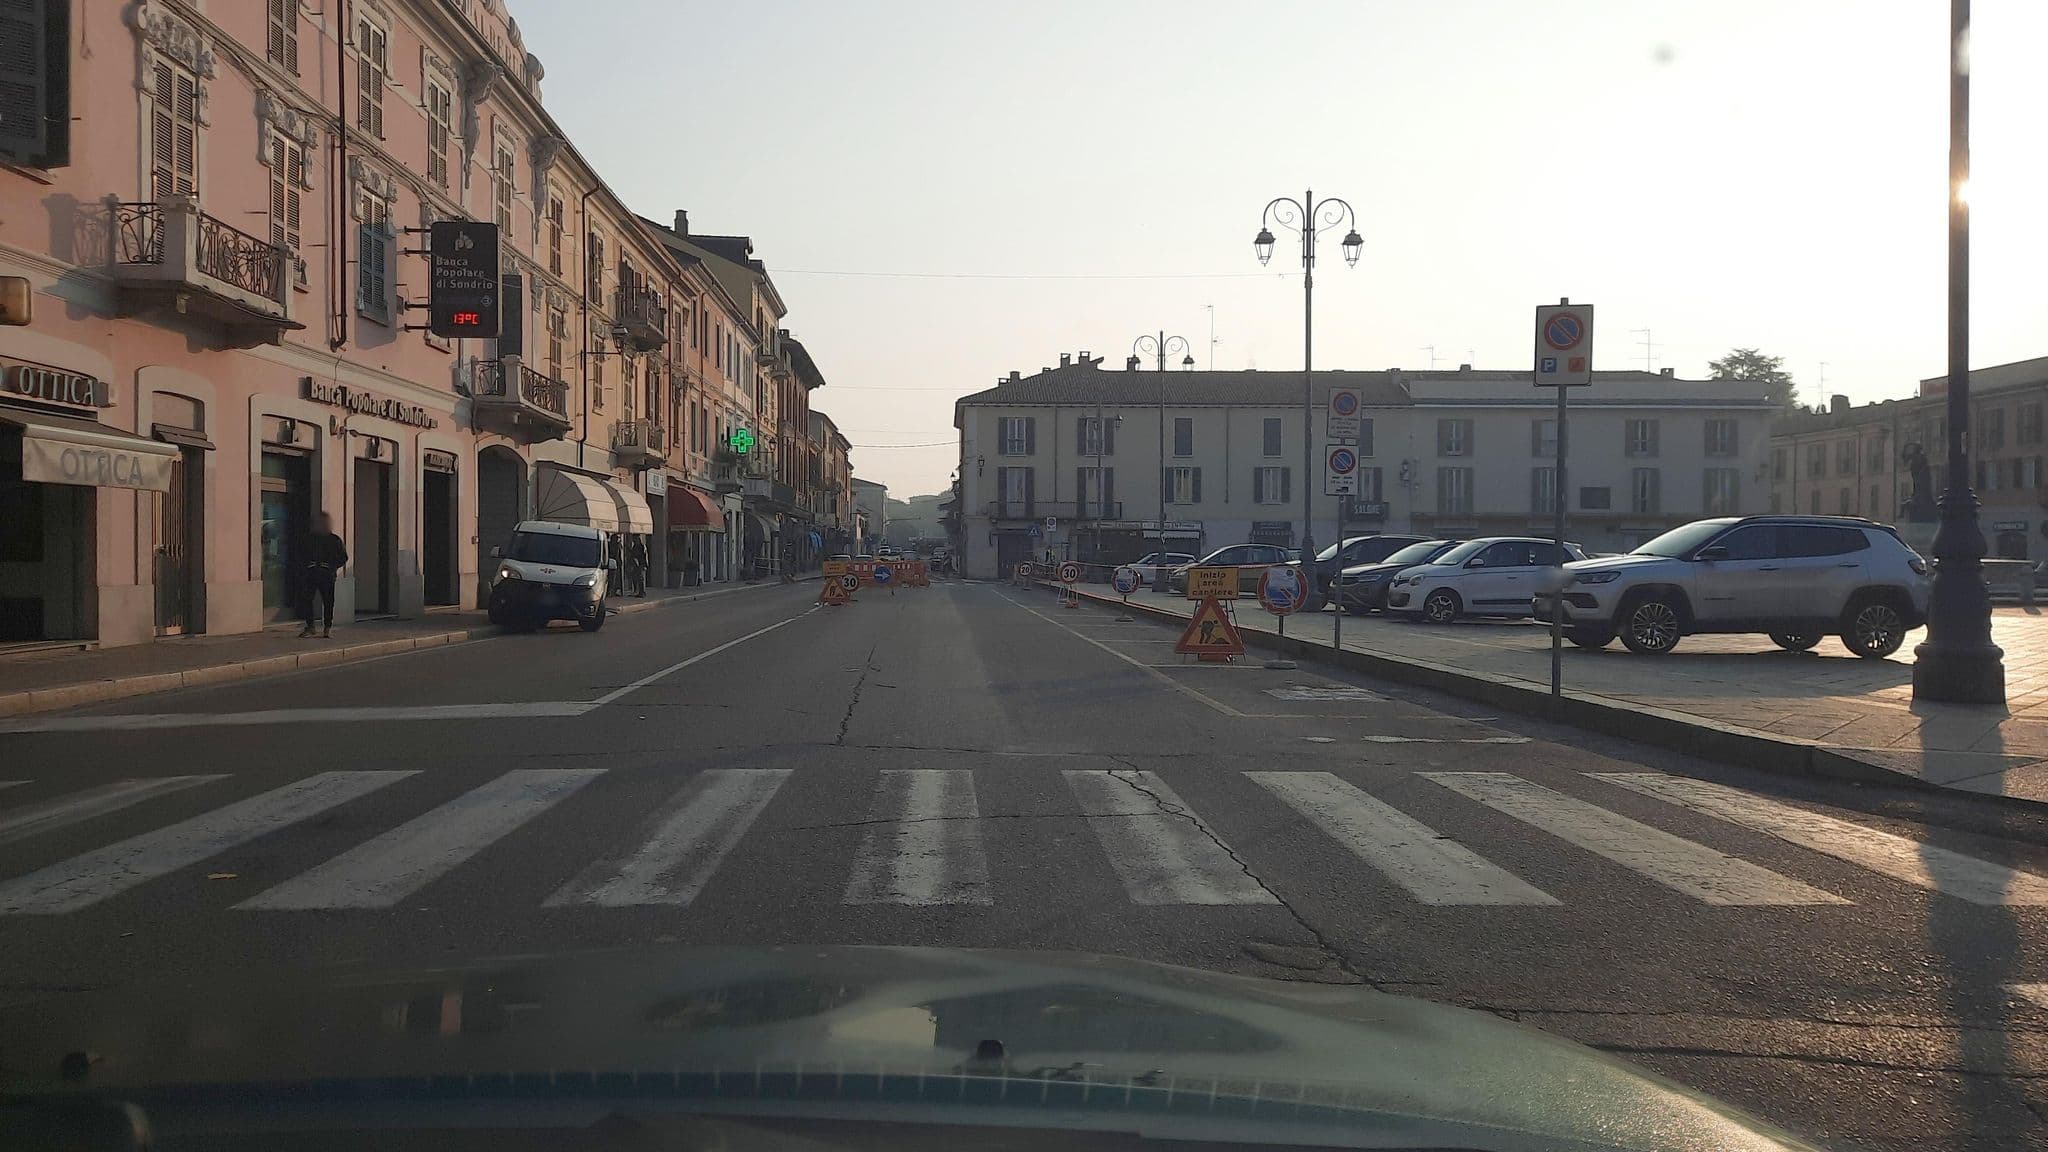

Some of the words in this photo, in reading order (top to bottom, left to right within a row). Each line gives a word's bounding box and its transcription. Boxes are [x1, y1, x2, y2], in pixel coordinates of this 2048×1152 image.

[437, 257, 468, 266] Banca
[436, 268, 484, 278] Popolare
[436, 279, 446, 289] di
[450, 279, 493, 289] Sondrio
[19, 366, 95, 406] OTTICA
[311, 382, 343, 406] Banca
[346, 389, 388, 416] Popolare
[388, 400, 397, 419] di
[399, 405, 431, 428] Sondrio
[60, 448, 144, 485] OTTICA
[1063, 568, 1076, 579] 30
[1199, 571, 1227, 579] inizio
[843, 577, 857, 588] 30
[1192, 588, 1234, 597] cantiere
